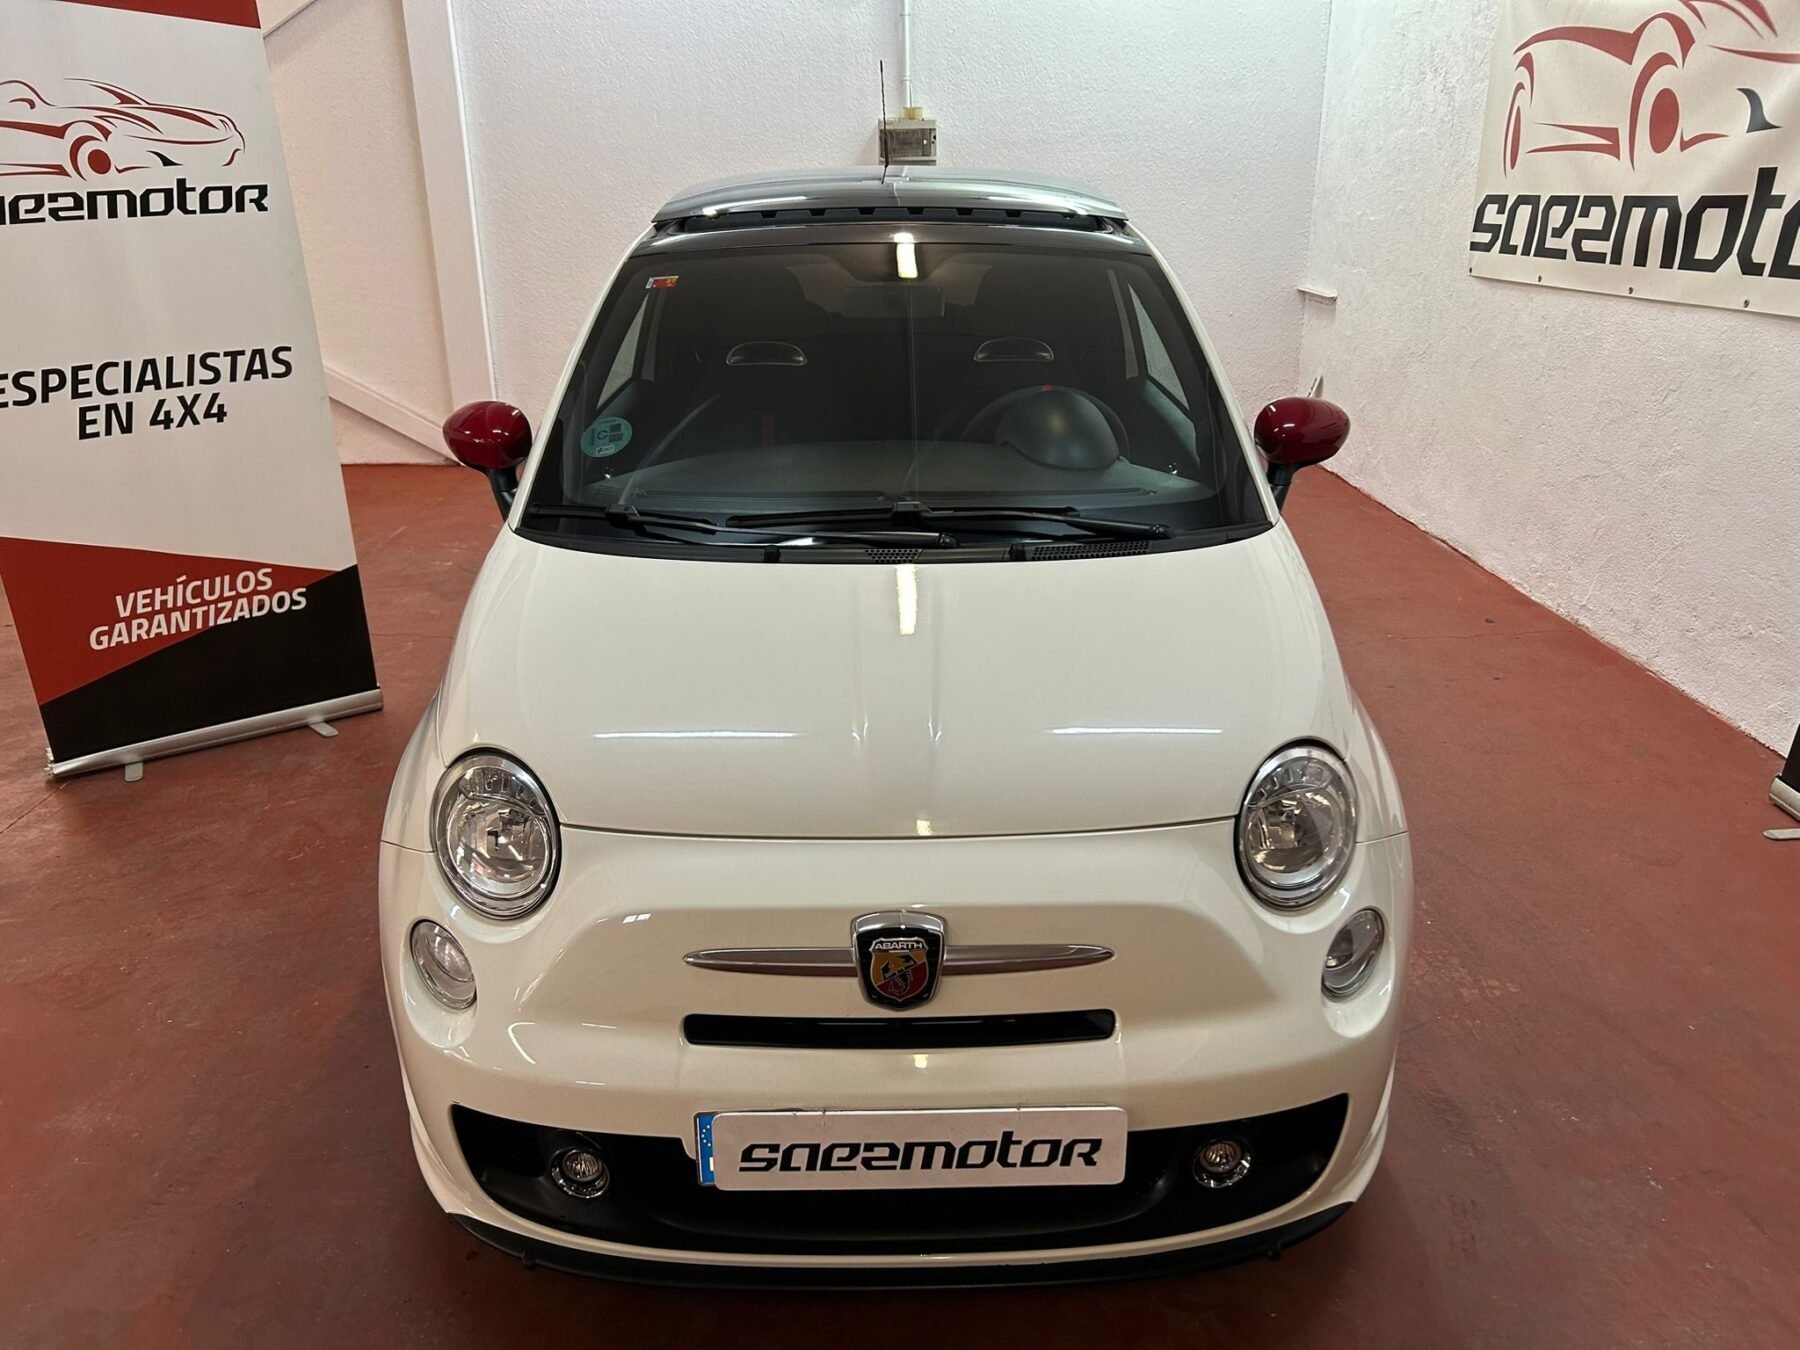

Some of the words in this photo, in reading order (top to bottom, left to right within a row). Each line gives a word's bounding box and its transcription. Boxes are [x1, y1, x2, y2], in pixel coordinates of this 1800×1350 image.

[79, 401, 134, 440] EN
[149, 392, 228, 430] 4X4
[115, 567, 274, 618] VEHÍCULOS
[89, 587, 308, 651] GARANTIZADOS
[874, 941, 923, 950] ABARTH
